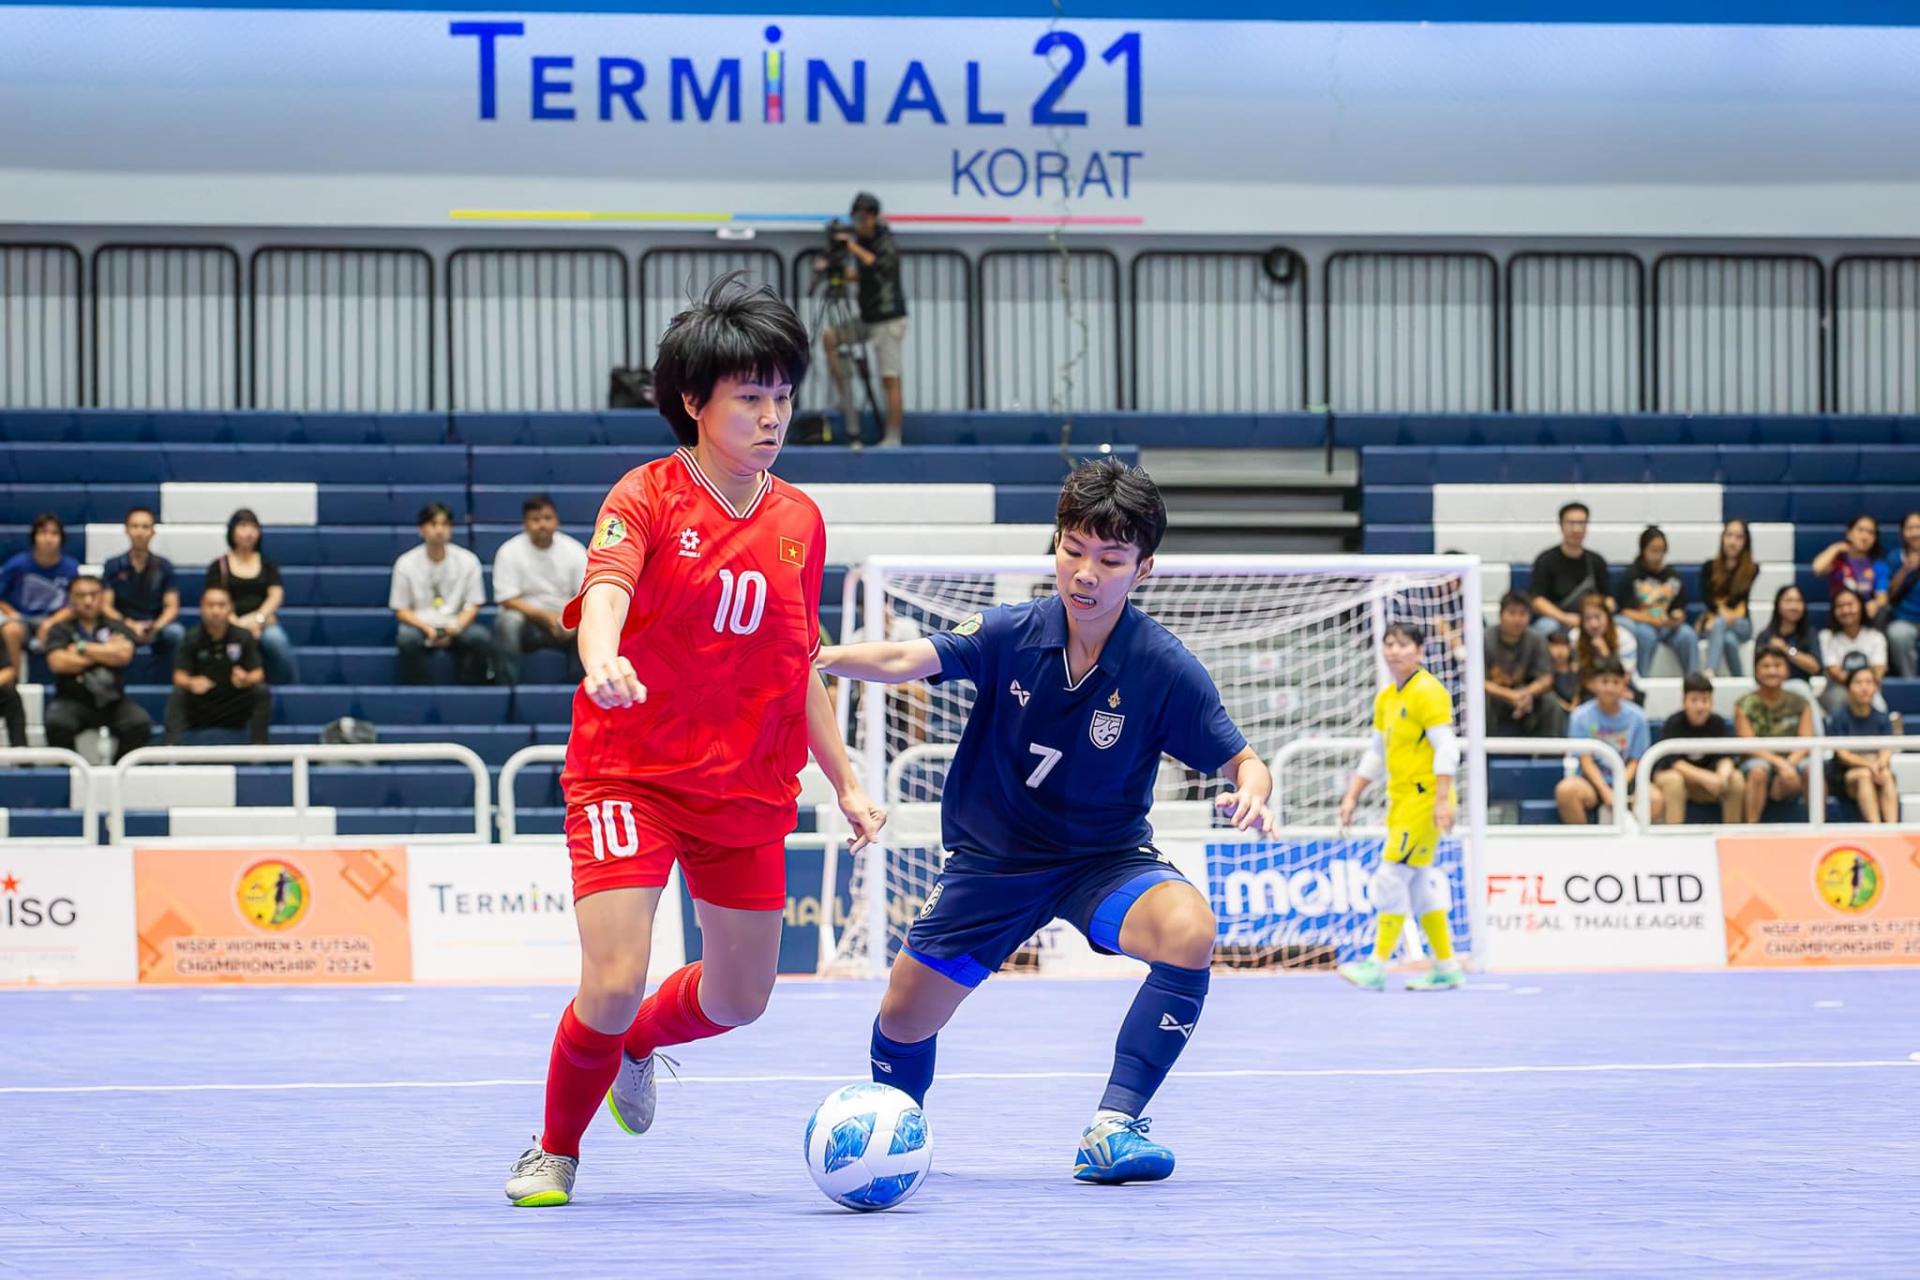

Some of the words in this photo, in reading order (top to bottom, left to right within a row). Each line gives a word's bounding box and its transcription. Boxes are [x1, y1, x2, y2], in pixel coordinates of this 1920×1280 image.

[1030, 31, 1143, 127] 21
[952, 149, 1144, 198] KORAT
[712, 568, 768, 636] 10
[1025, 742, 1064, 789] 7
[583, 800, 639, 861] 10
[1487, 913, 1564, 931] FUTSAL
